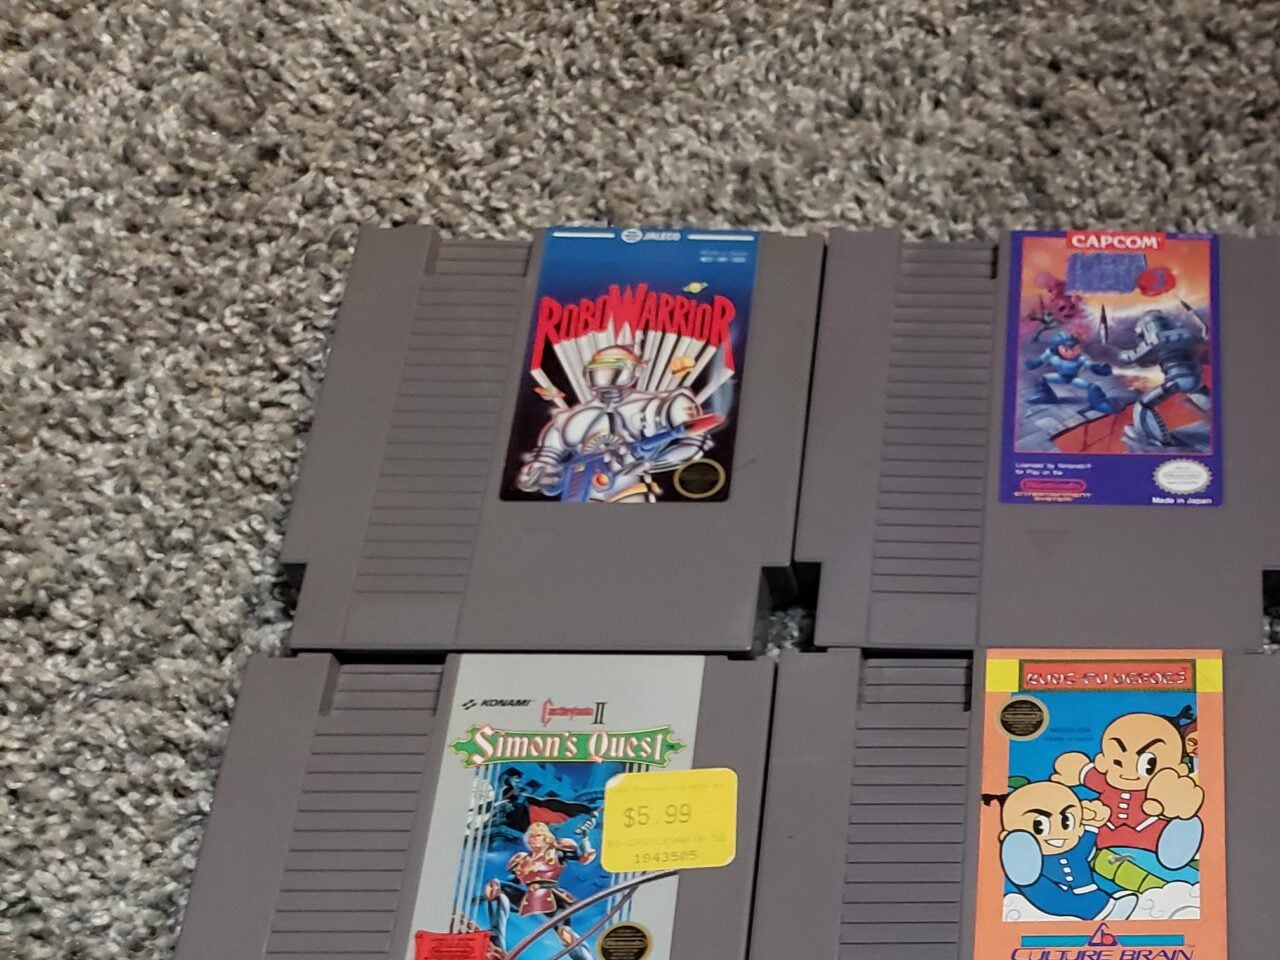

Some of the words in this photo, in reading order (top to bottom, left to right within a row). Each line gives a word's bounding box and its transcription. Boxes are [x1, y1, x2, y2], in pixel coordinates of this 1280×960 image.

[1071, 234, 1159, 250] CAPCOM
[1026, 672, 1076, 685] KUNG
[1082, 672, 1108, 685] FU
[480, 699, 532, 708] KONAMI
[471, 725, 578, 764] Simon's
[588, 729, 666, 763] Quest
